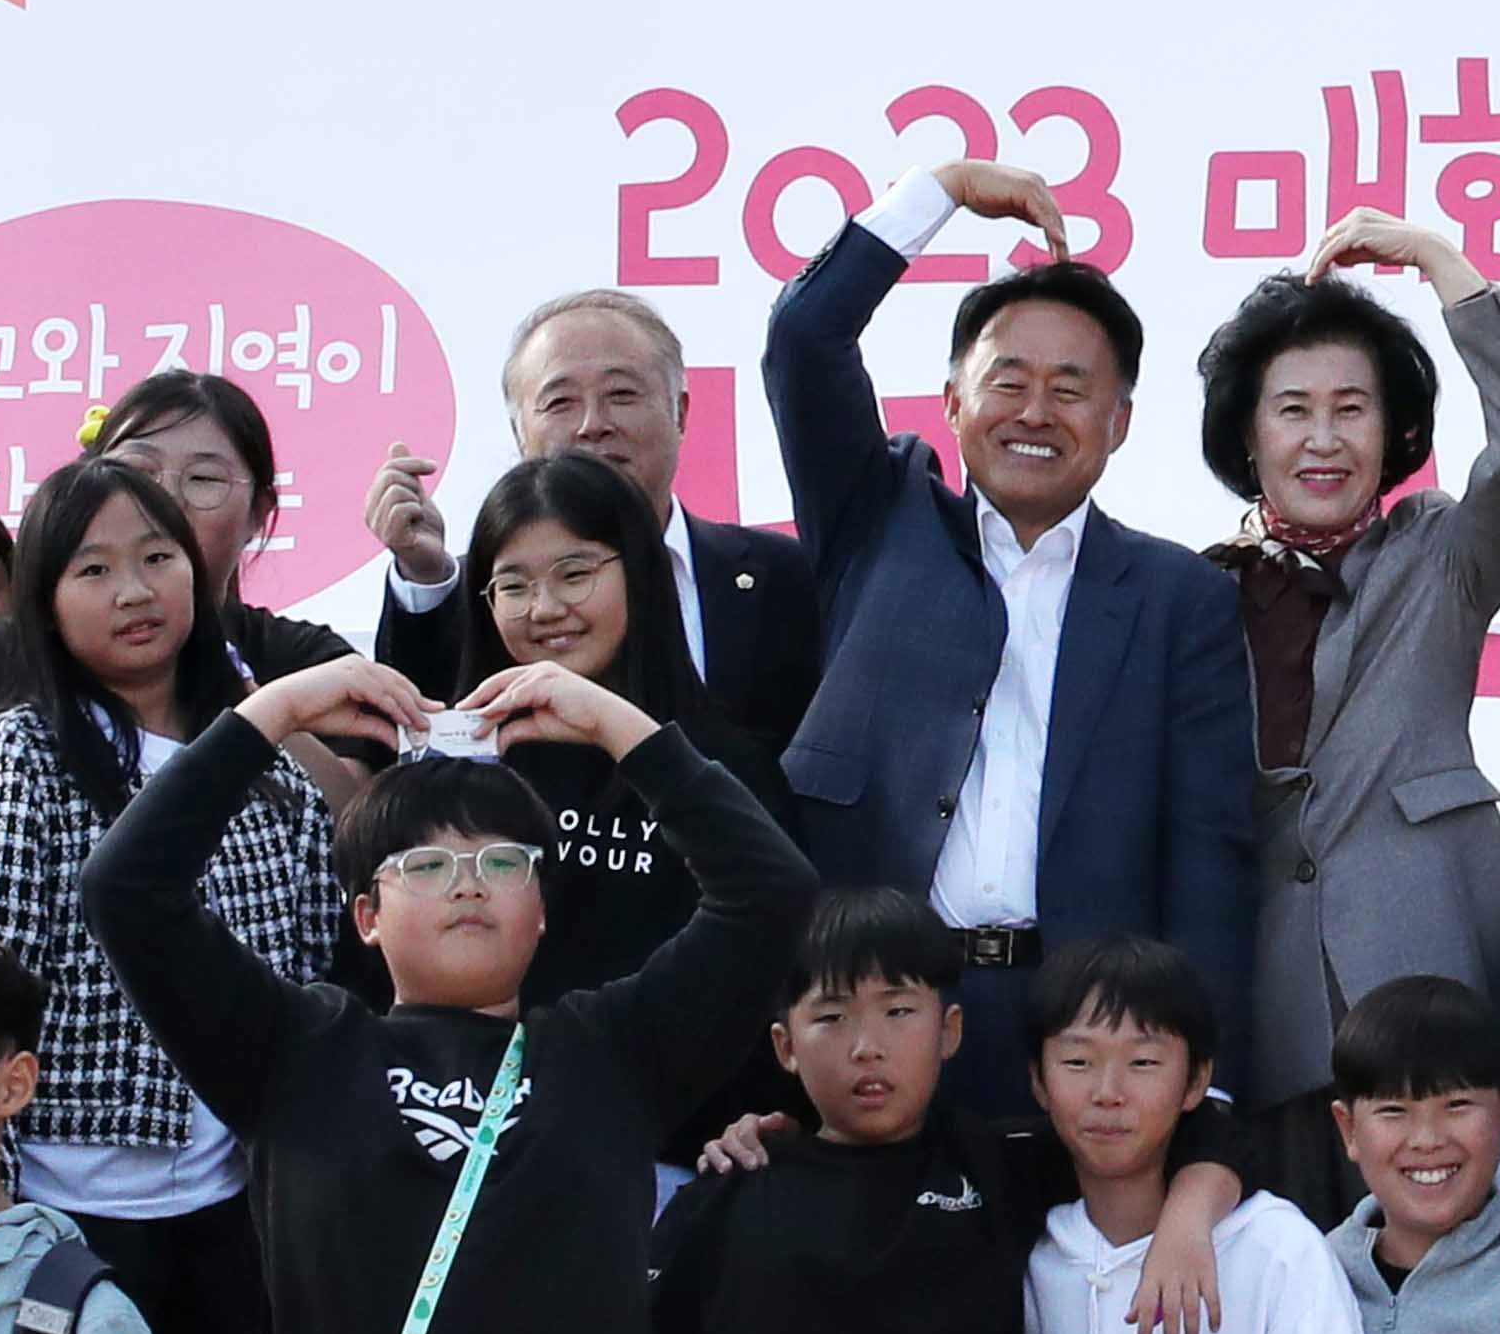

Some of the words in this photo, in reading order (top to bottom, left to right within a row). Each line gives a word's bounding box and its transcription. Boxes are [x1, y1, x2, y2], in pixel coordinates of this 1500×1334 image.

[614, 85, 1135, 287] 2023
[143, 303, 397, 410] 지역이
[386, 1067, 533, 1113] Reebk
